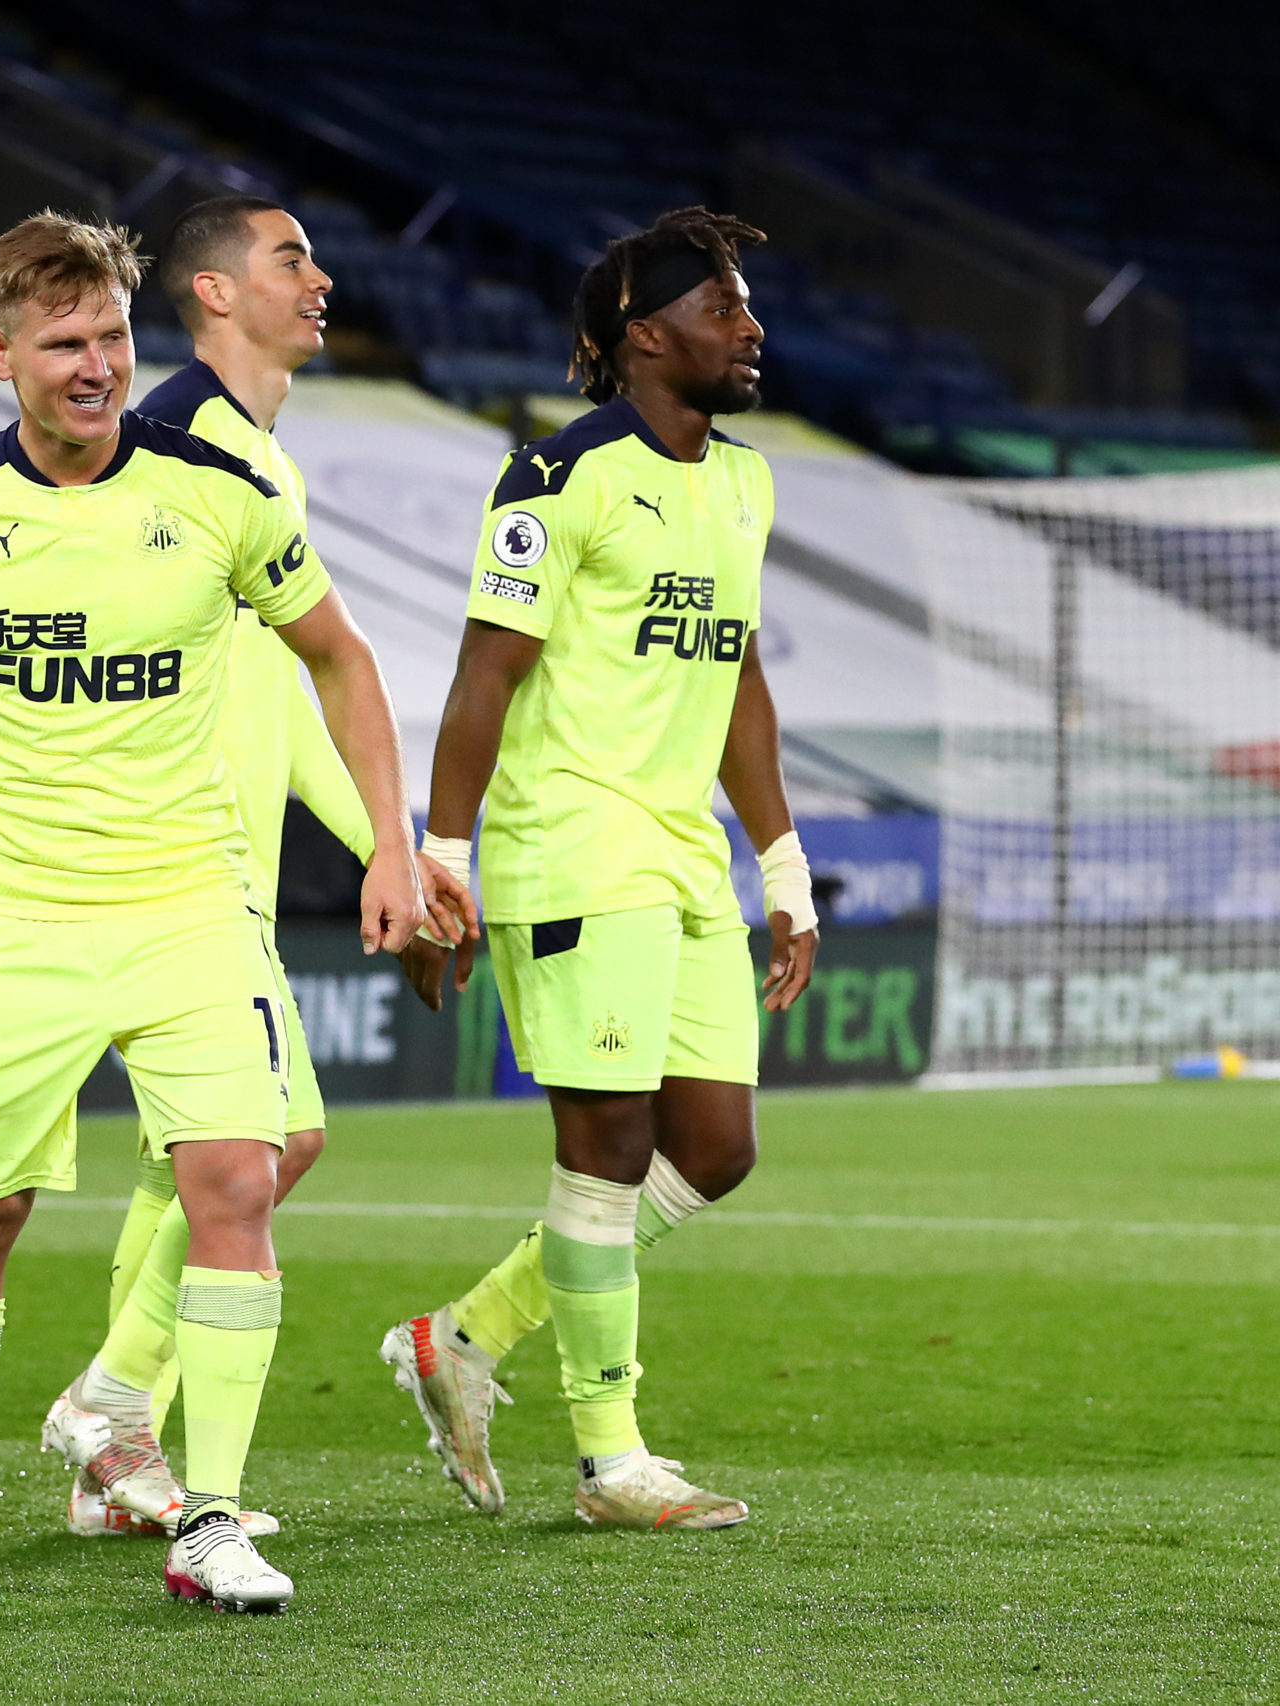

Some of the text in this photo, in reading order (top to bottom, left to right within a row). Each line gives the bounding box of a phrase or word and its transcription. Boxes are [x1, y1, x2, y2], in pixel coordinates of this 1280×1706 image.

[480, 570, 534, 595] No room
[644, 571, 715, 611] 乐天堂
[634, 615, 748, 662] FUN8
[253, 997, 288, 1076] 1
[755, 969, 922, 1074] TER
